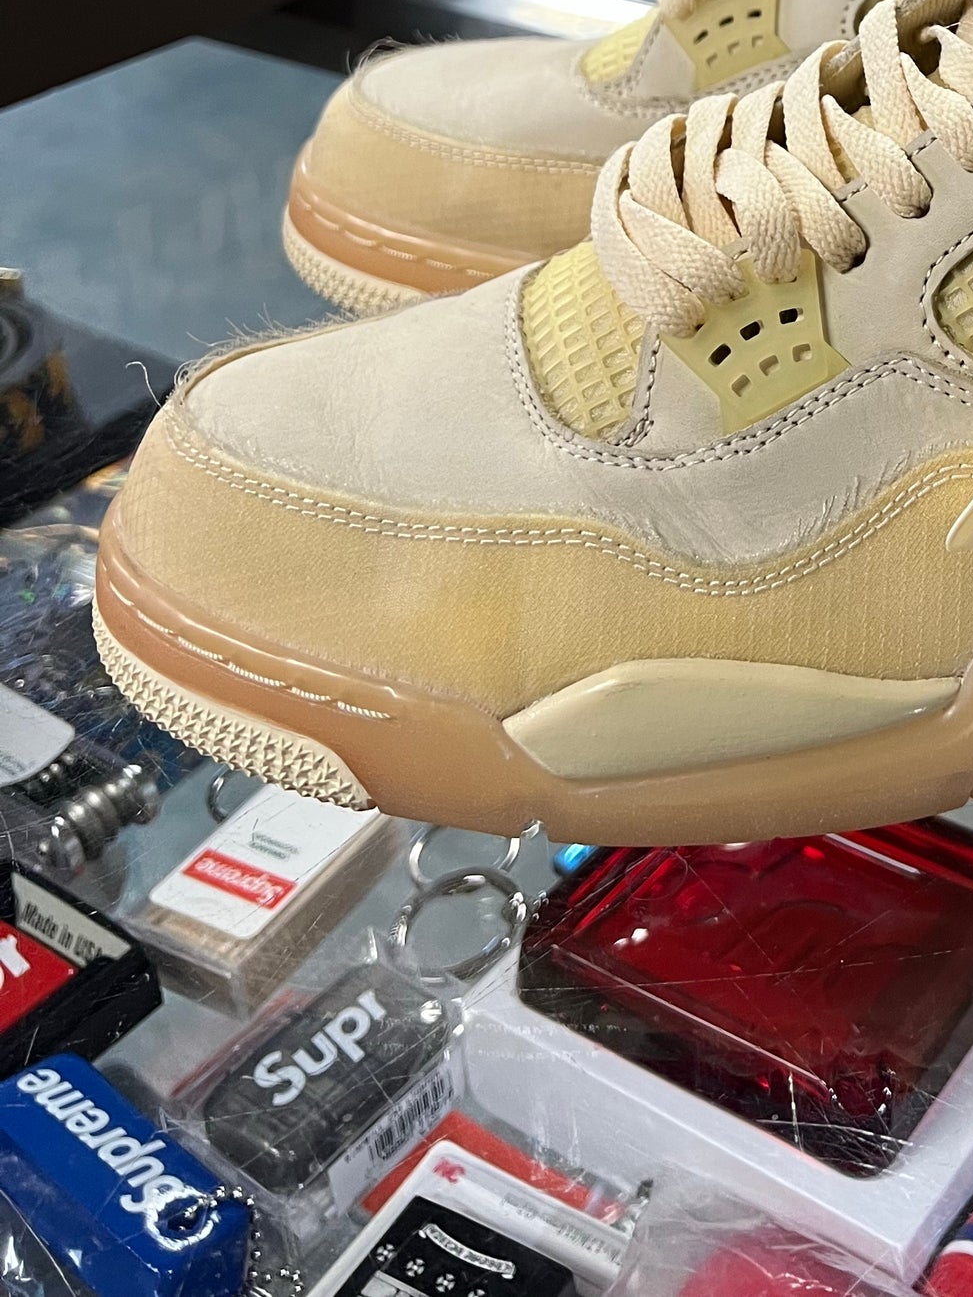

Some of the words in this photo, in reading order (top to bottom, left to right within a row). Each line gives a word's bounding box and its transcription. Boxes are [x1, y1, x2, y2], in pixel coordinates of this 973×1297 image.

[194, 856, 284, 905] Supreme
[22, 903, 59, 939] Made
[16, 1068, 188, 1215] Supreme
